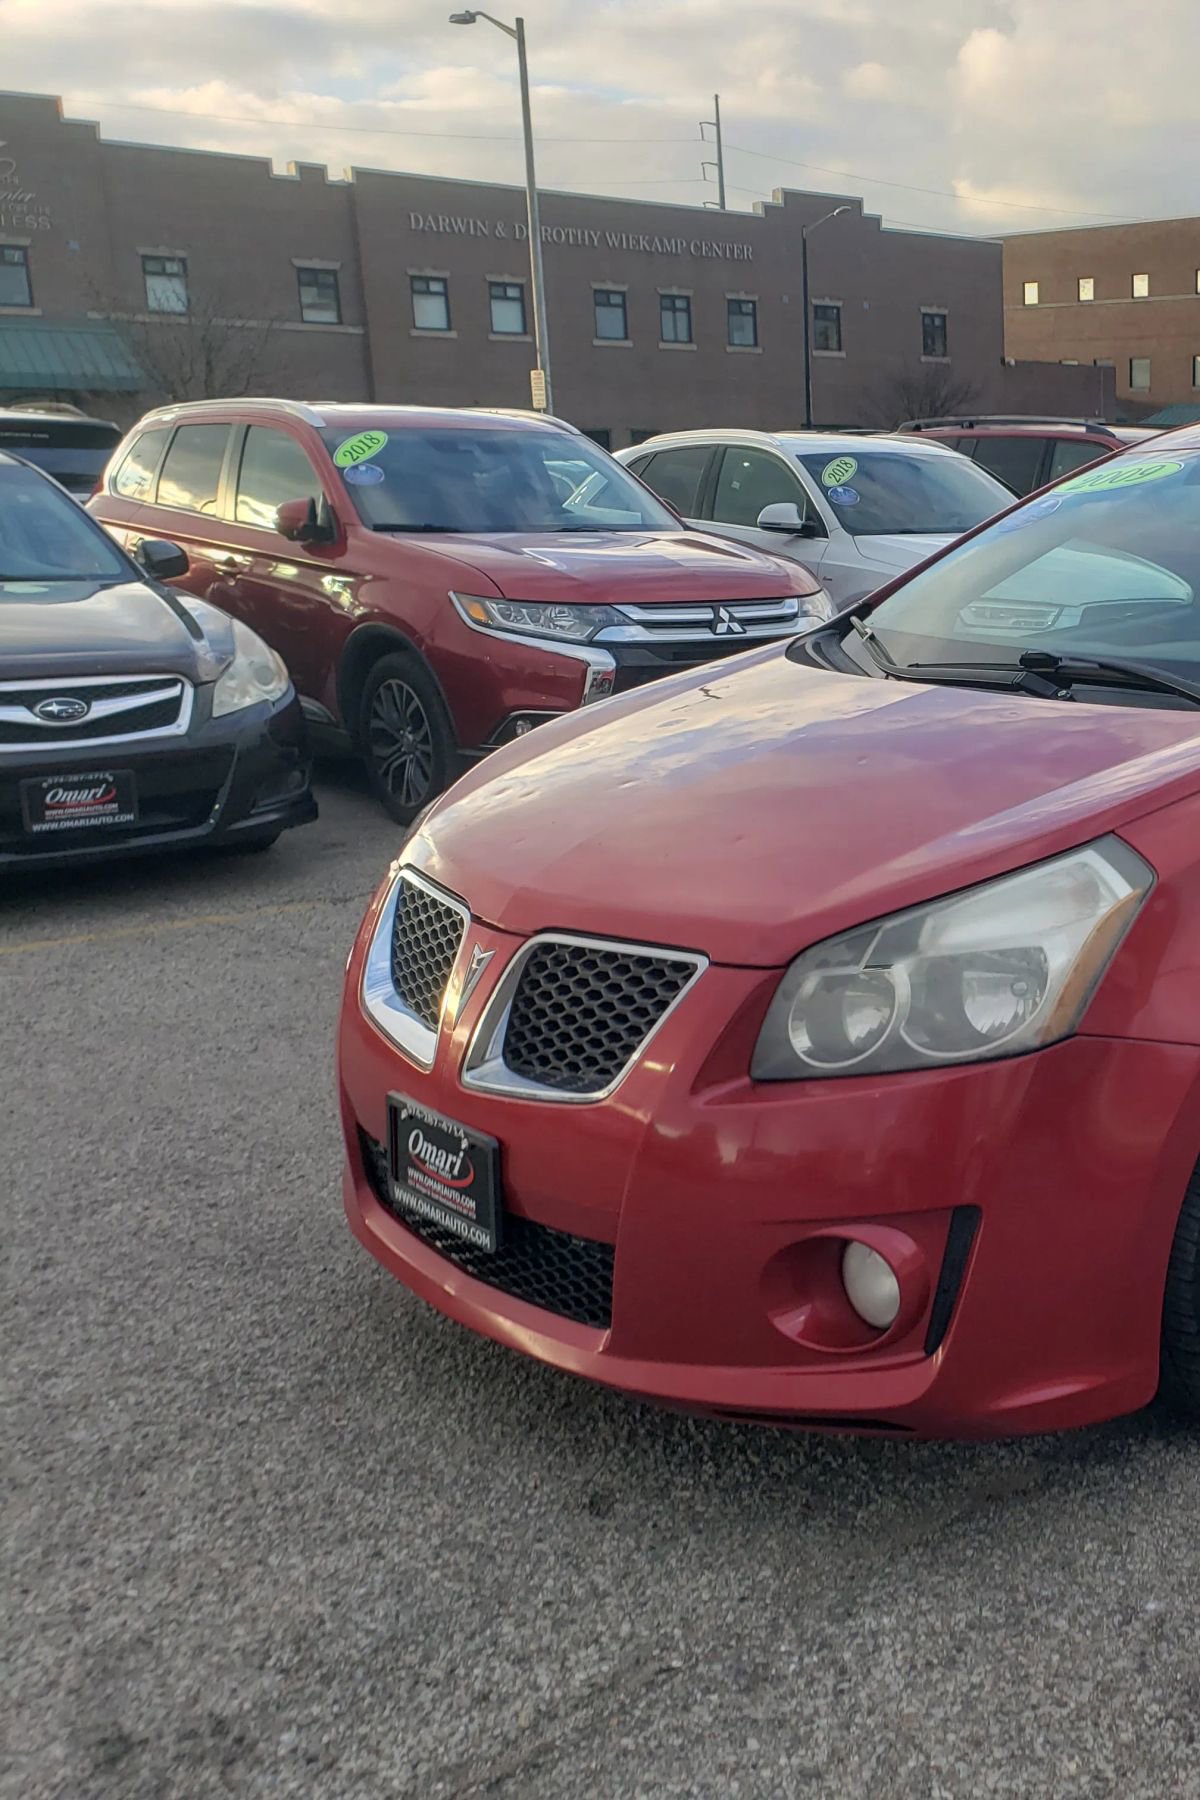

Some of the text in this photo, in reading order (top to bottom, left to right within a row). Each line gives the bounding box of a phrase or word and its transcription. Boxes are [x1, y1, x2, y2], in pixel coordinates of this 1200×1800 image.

[409, 212, 753, 260] DARWIN & DROTHY WIEKAMP CENTER
[342, 433, 381, 462] 2018
[827, 459, 853, 483] 2018
[1064, 464, 1167, 491] 2009
[45, 783, 106, 804] Omari
[32, 813, 134, 832] WWW.OMARIAUTO.COM
[408, 1129, 464, 1176] Omari
[407, 1166, 476, 1209] WWW.OMARIAUTO.COM
[394, 1185, 490, 1249] WWW.OMARIAUTO.COM
